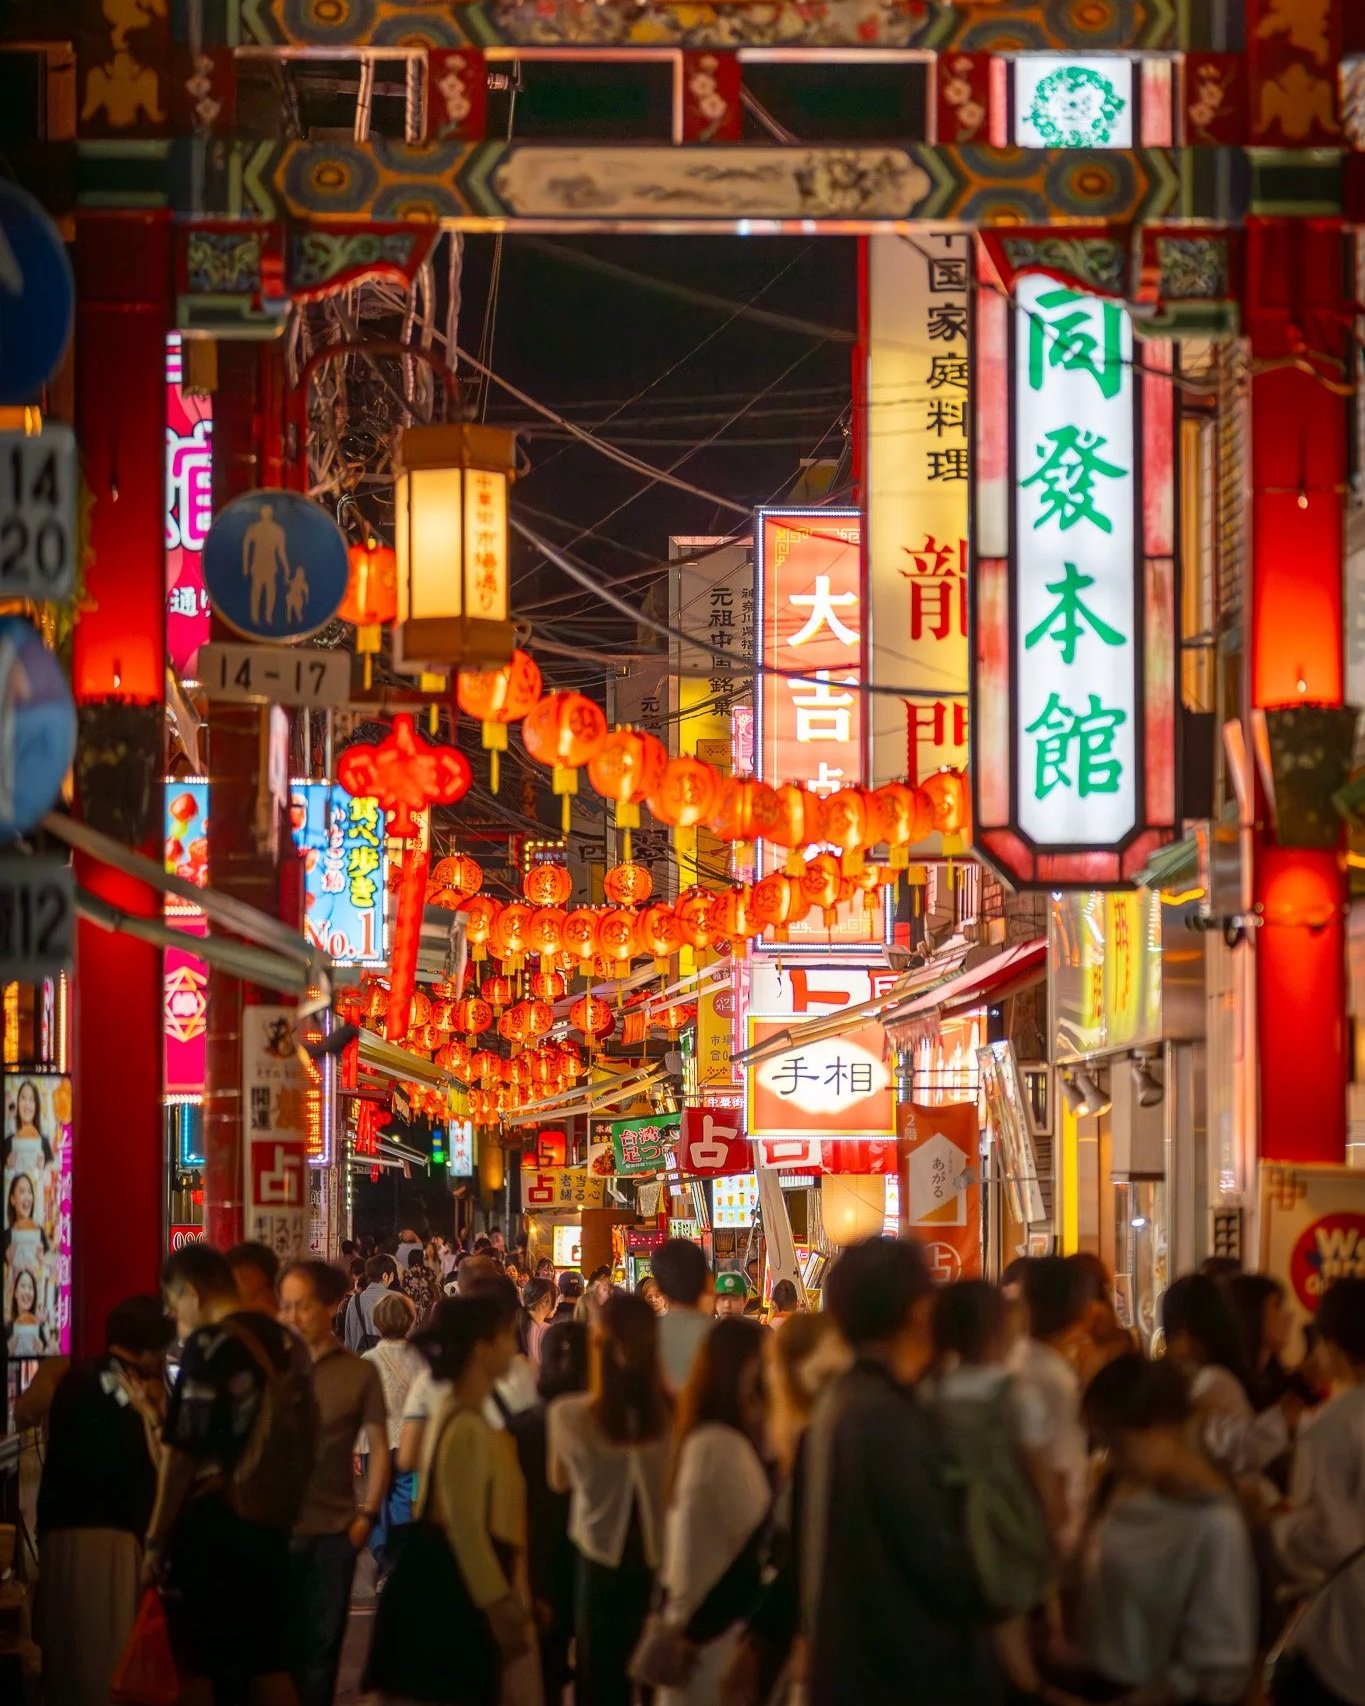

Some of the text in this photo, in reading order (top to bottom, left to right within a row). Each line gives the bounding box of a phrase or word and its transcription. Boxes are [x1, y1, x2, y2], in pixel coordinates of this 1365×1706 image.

[1020, 290, 1128, 800] 同發本館
[348, 796, 380, 908] 食べ歩き
[305, 907, 379, 960] No.1
[771, 1056, 874, 1096] 手相
[689, 1114, 738, 1168] 占
[260, 1144, 301, 1201] 占
[528, 1174, 555, 1203] 占
[931, 1157, 946, 1199] あがる
